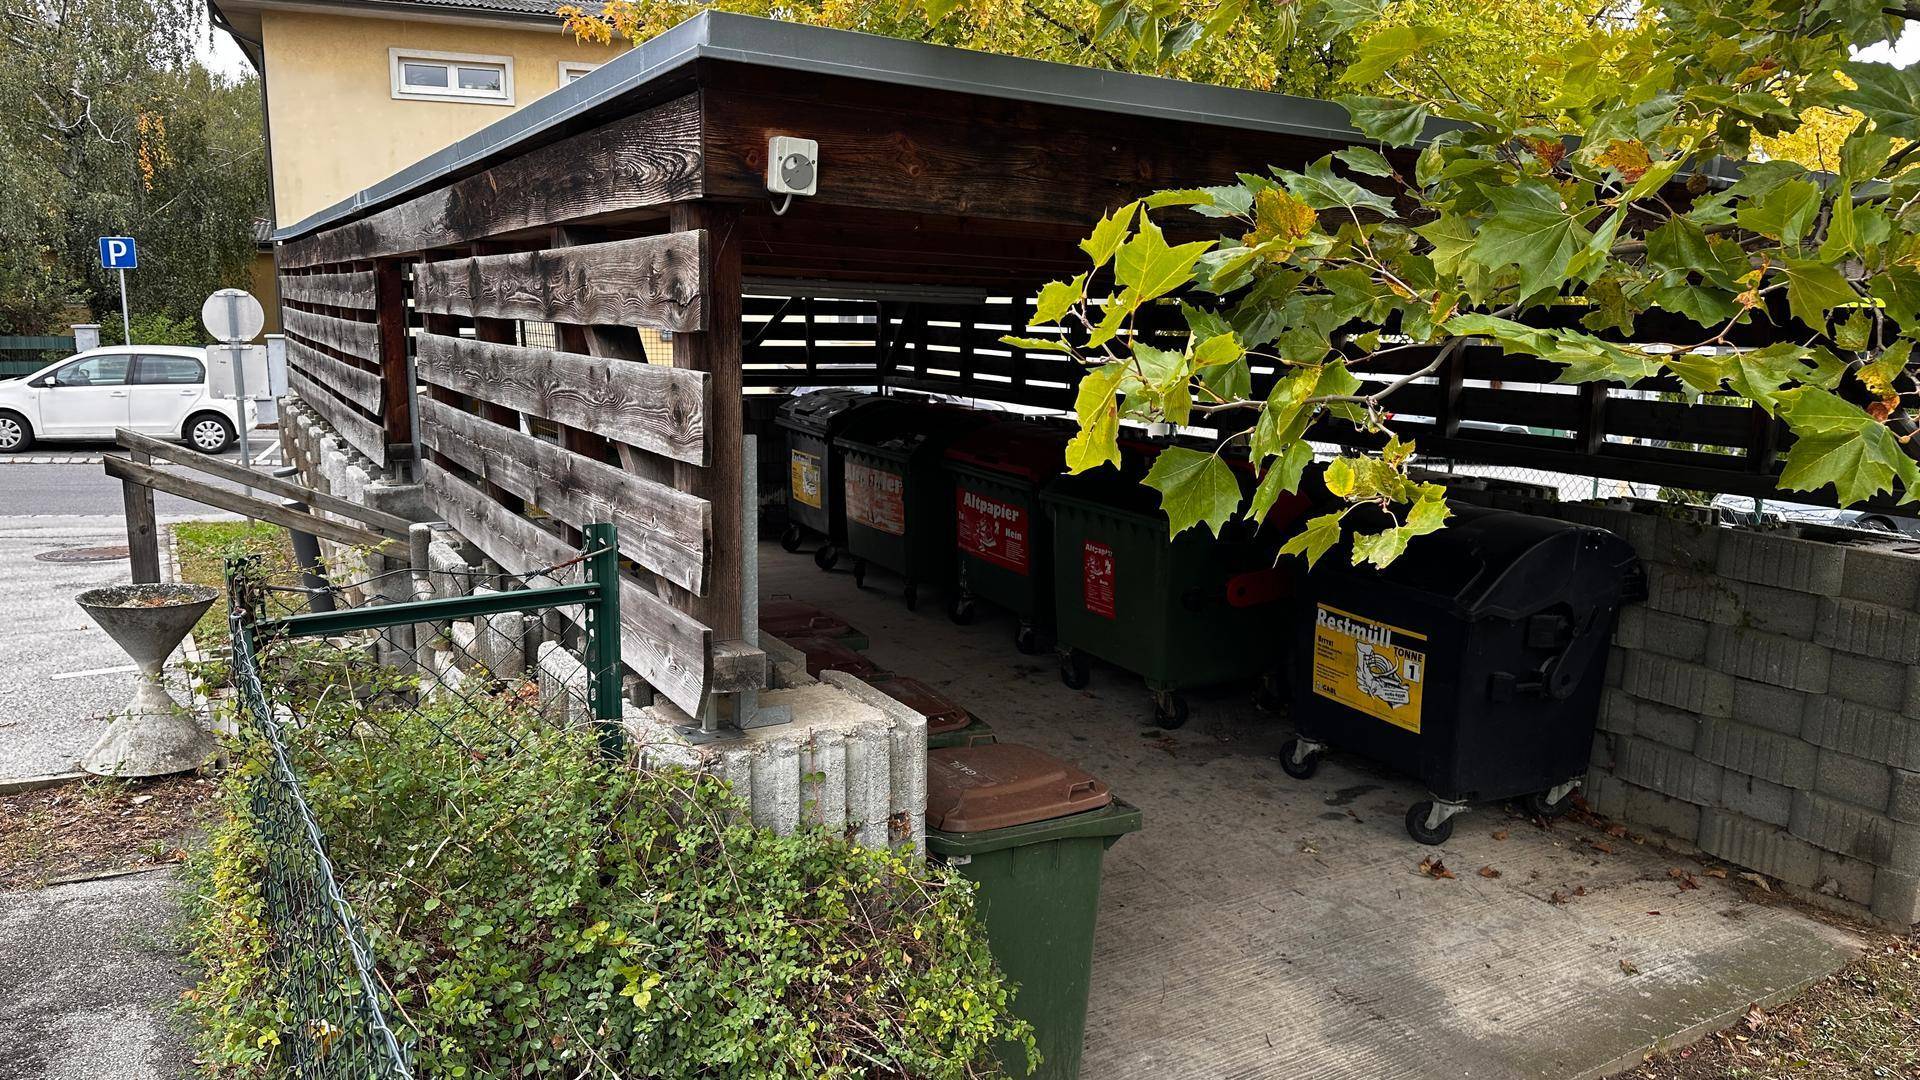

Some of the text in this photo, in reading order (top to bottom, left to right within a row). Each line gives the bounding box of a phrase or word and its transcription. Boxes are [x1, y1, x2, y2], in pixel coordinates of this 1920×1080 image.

[108, 240, 127, 266] P
[963, 492, 1020, 522] Altpapier
[1005, 527, 1022, 541] Nein
[1316, 607, 1392, 649] Restmüll
[1394, 646, 1423, 663] TONNE
[1408, 664, 1415, 680] 1
